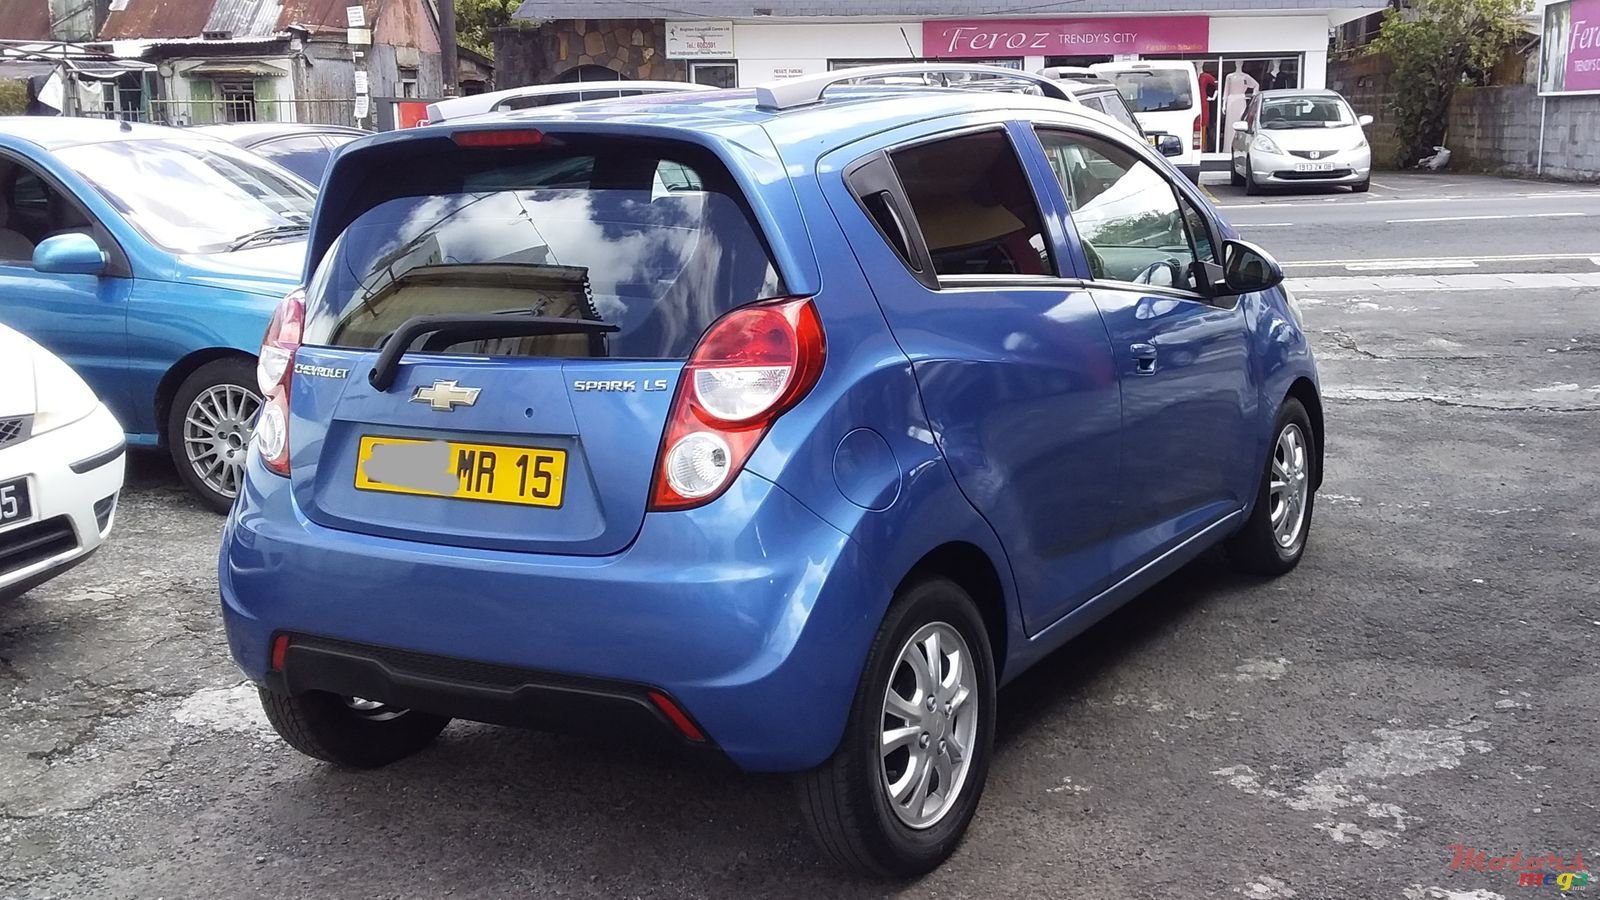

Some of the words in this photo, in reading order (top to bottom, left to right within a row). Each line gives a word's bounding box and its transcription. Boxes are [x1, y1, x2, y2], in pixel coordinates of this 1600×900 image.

[943, 26, 1050, 53] Feroz
[1058, 33, 1110, 45] TRENDY'S
[1112, 33, 1138, 43] CITY
[294, 363, 350, 379] CHEVROLET
[574, 380, 636, 392] SPARK
[643, 379, 668, 391] LS
[456, 449, 496, 494] MR
[516, 454, 554, 499] 15
[0, 485, 18, 519] 5
